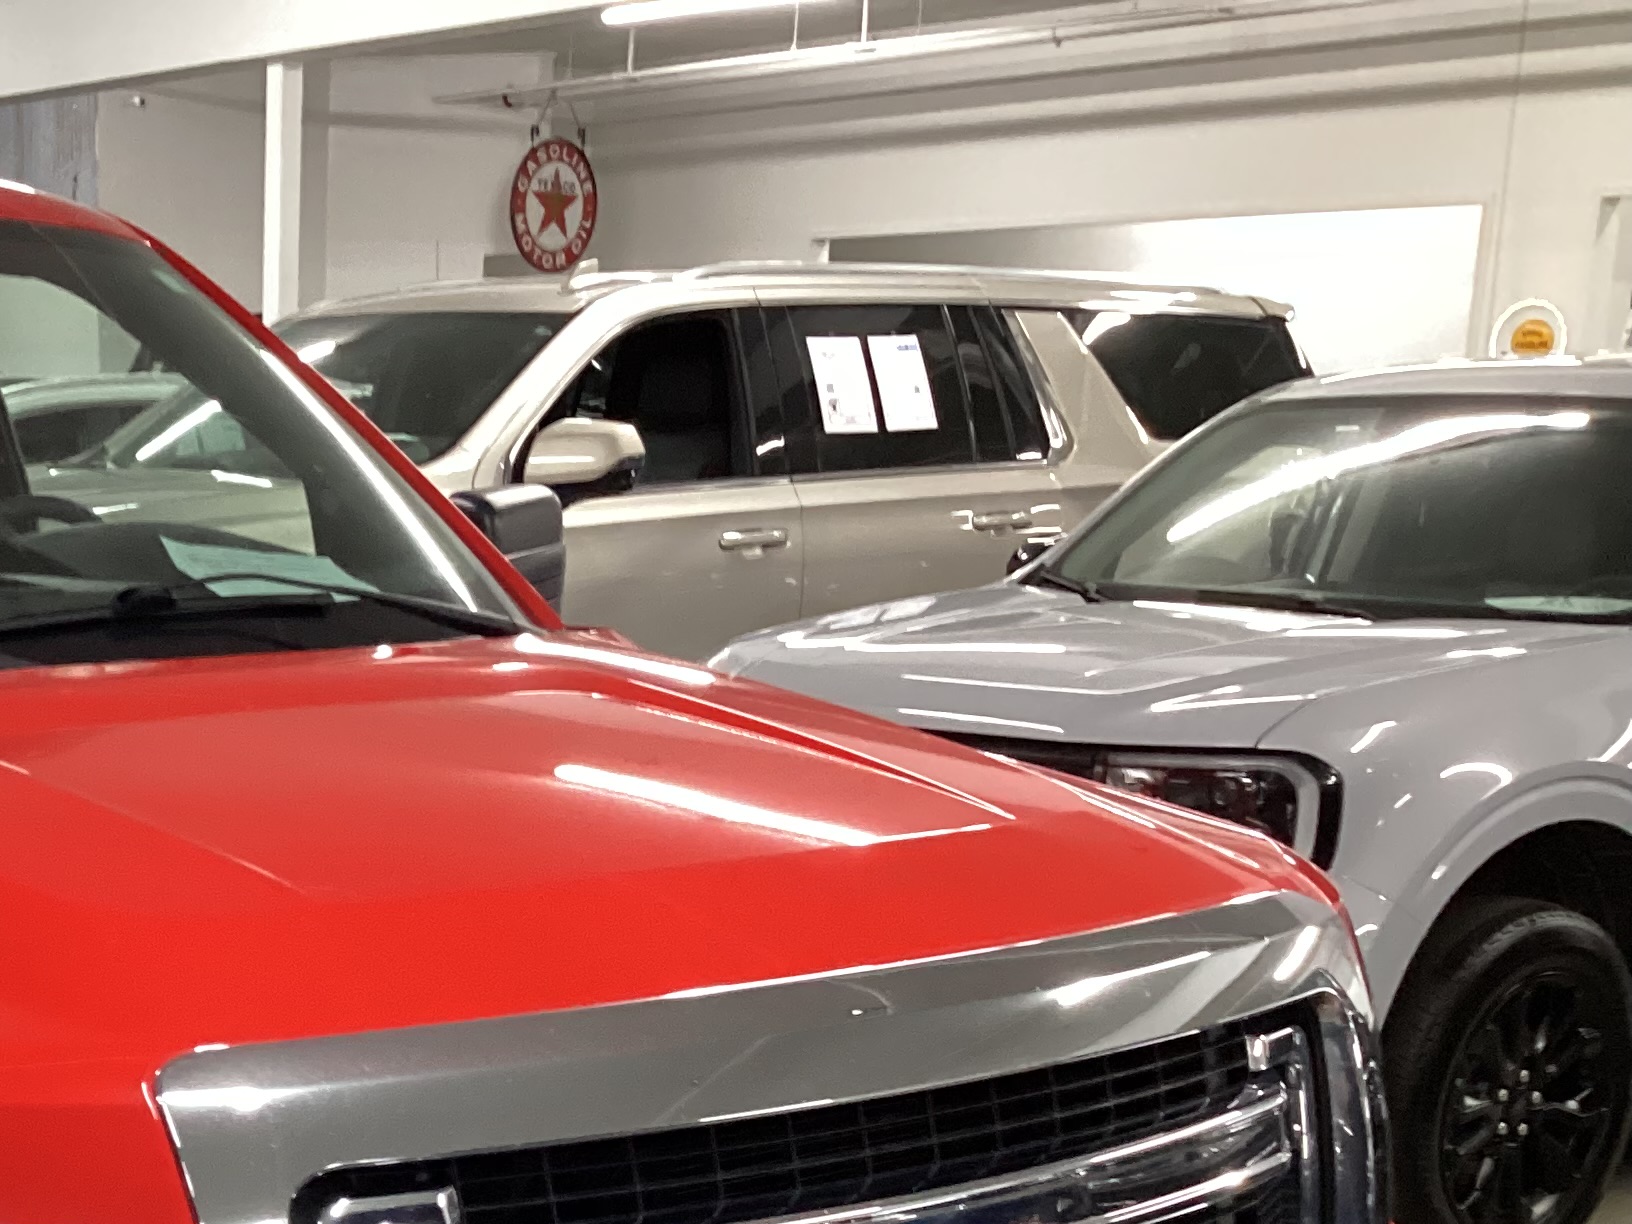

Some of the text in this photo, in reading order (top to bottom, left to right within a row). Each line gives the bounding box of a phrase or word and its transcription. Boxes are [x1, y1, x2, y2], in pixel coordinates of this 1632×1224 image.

[518, 143, 593, 197] GASOLINE
[537, 178, 576, 194] TECO
[515, 212, 592, 269] MOTOR OIL
